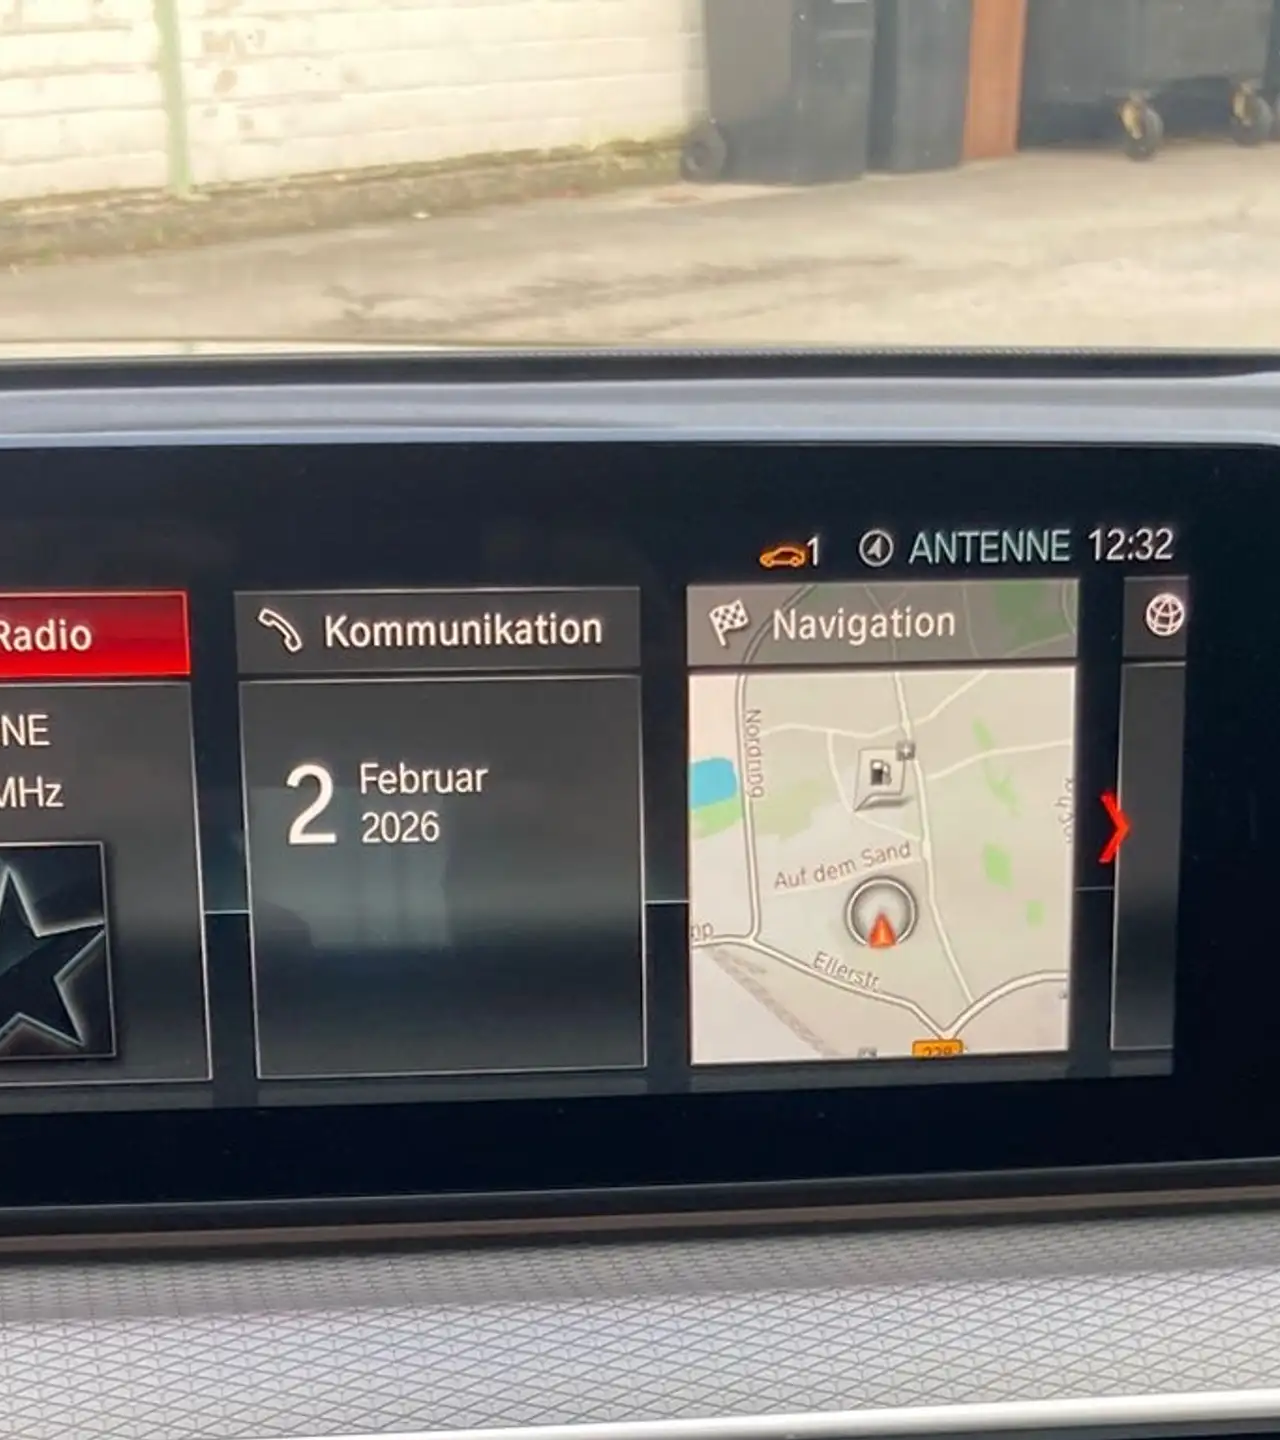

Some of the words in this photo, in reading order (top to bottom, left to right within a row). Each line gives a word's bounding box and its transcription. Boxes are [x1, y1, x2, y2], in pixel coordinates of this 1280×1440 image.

[806, 538, 821, 565] 1
[909, 529, 1071, 563] ANTENNE
[1089, 527, 1175, 561] 12:32
[324, 611, 603, 648] Kommunikation
[773, 607, 956, 648] Navigation
[360, 762, 488, 795] Februar
[286, 764, 338, 845] 2
[361, 811, 440, 843] 2026
[813, 858, 857, 882] dem
[861, 840, 912, 868] Sand
